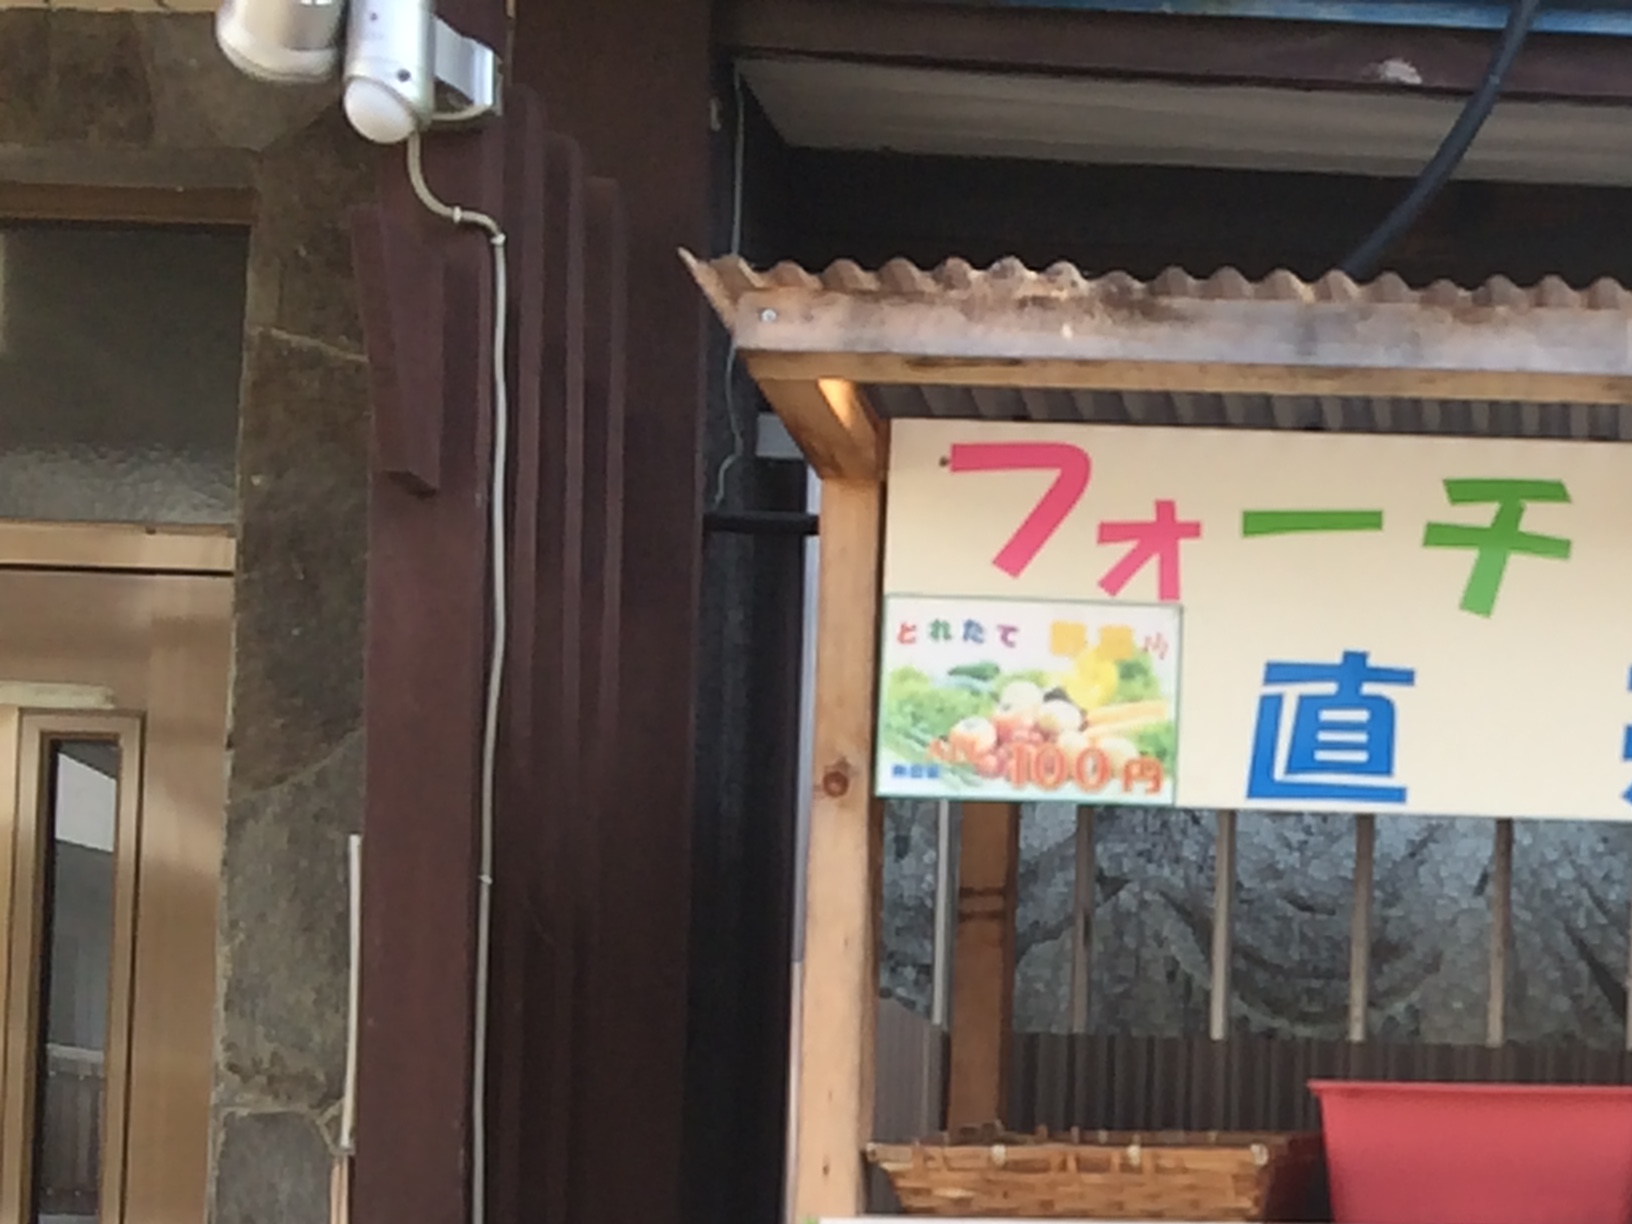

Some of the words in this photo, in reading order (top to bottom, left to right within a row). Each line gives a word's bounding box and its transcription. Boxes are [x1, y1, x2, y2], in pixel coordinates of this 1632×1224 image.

[896, 618, 1020, 649] とれたて
[1005, 740, 1165, 794] 100円
